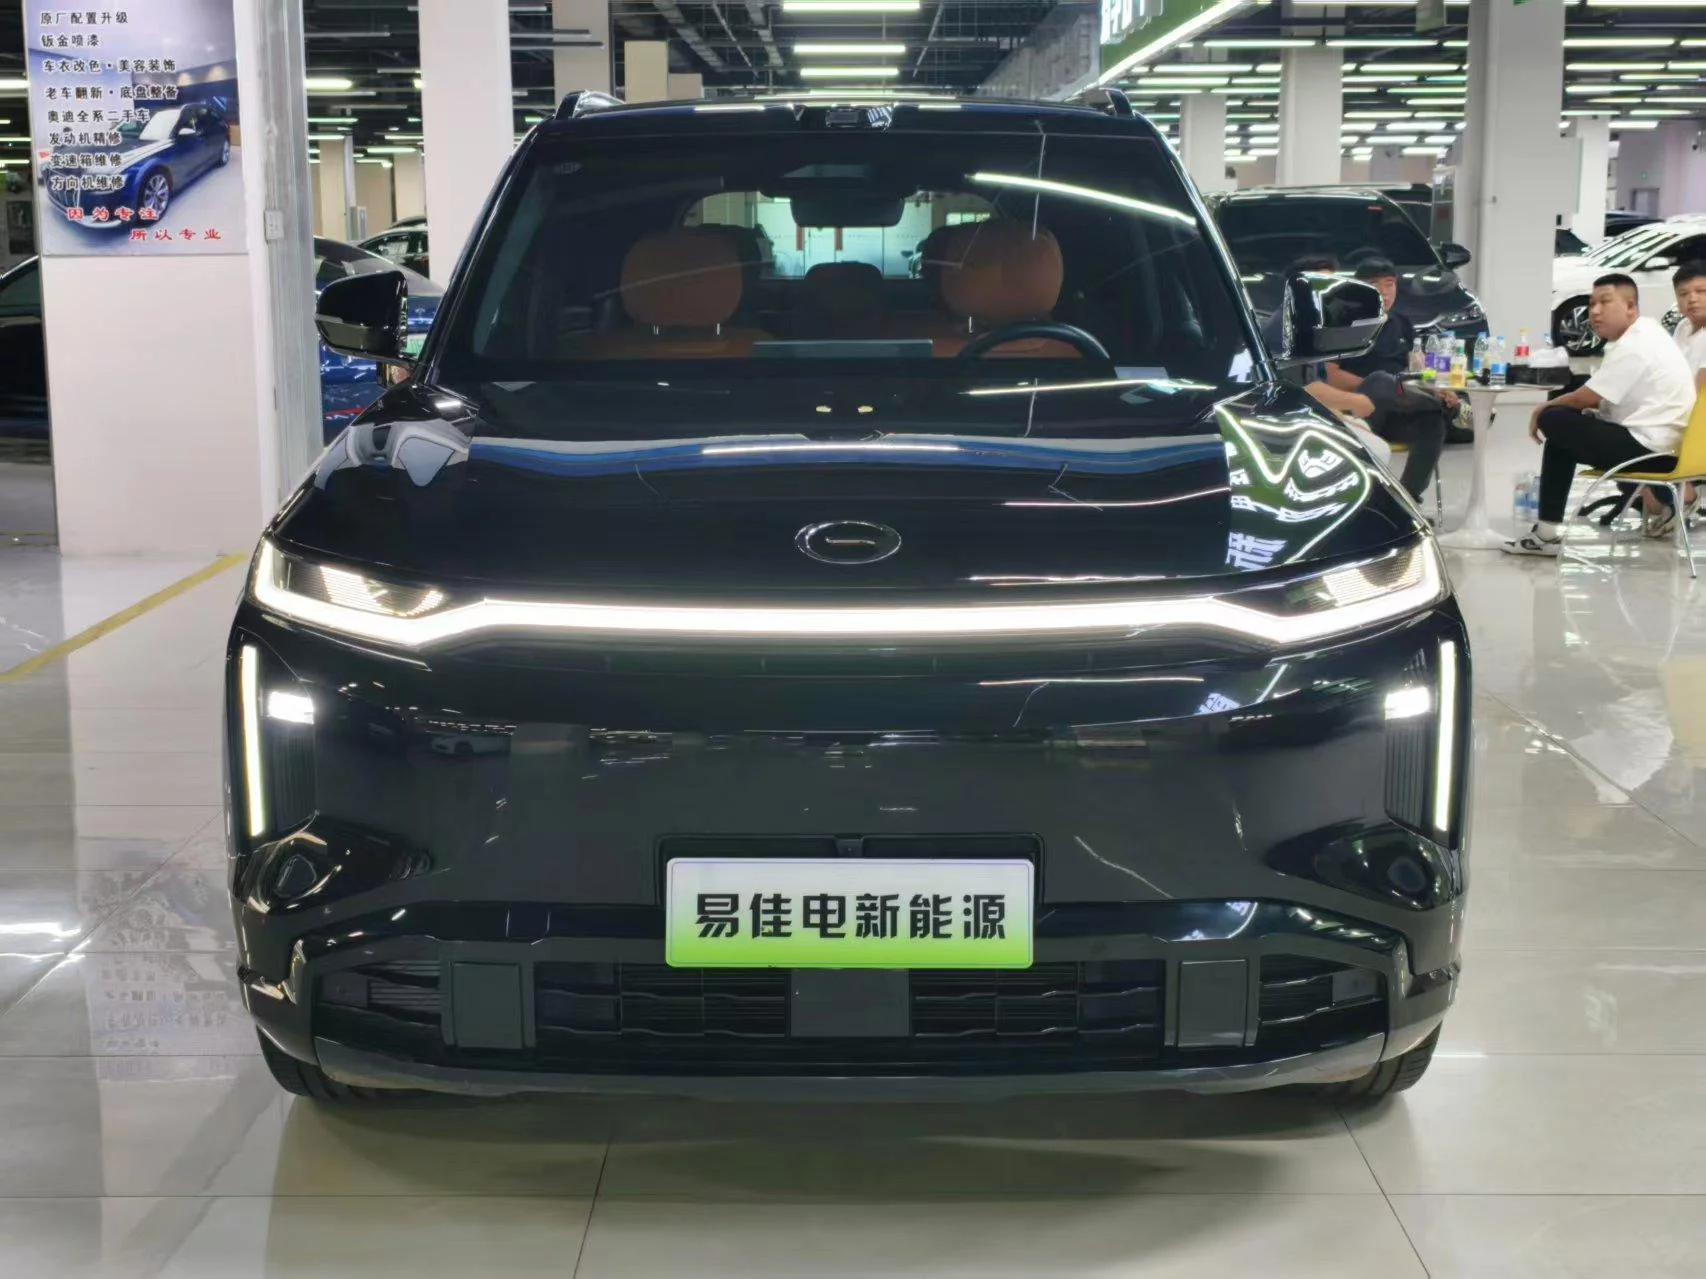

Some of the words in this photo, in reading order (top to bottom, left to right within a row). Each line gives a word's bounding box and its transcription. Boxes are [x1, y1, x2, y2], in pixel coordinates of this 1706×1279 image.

[41, 11, 128, 24] 原厂配置升级
[41, 34, 99, 47] 钣金喷漆
[49, 131, 122, 145] 发动机精修
[52, 176, 124, 190] 方向机维修
[67, 207, 158, 221] 因为专注
[129, 228, 221, 241] 所以专业
[696, 892, 1006, 940] 易佳电新能源
